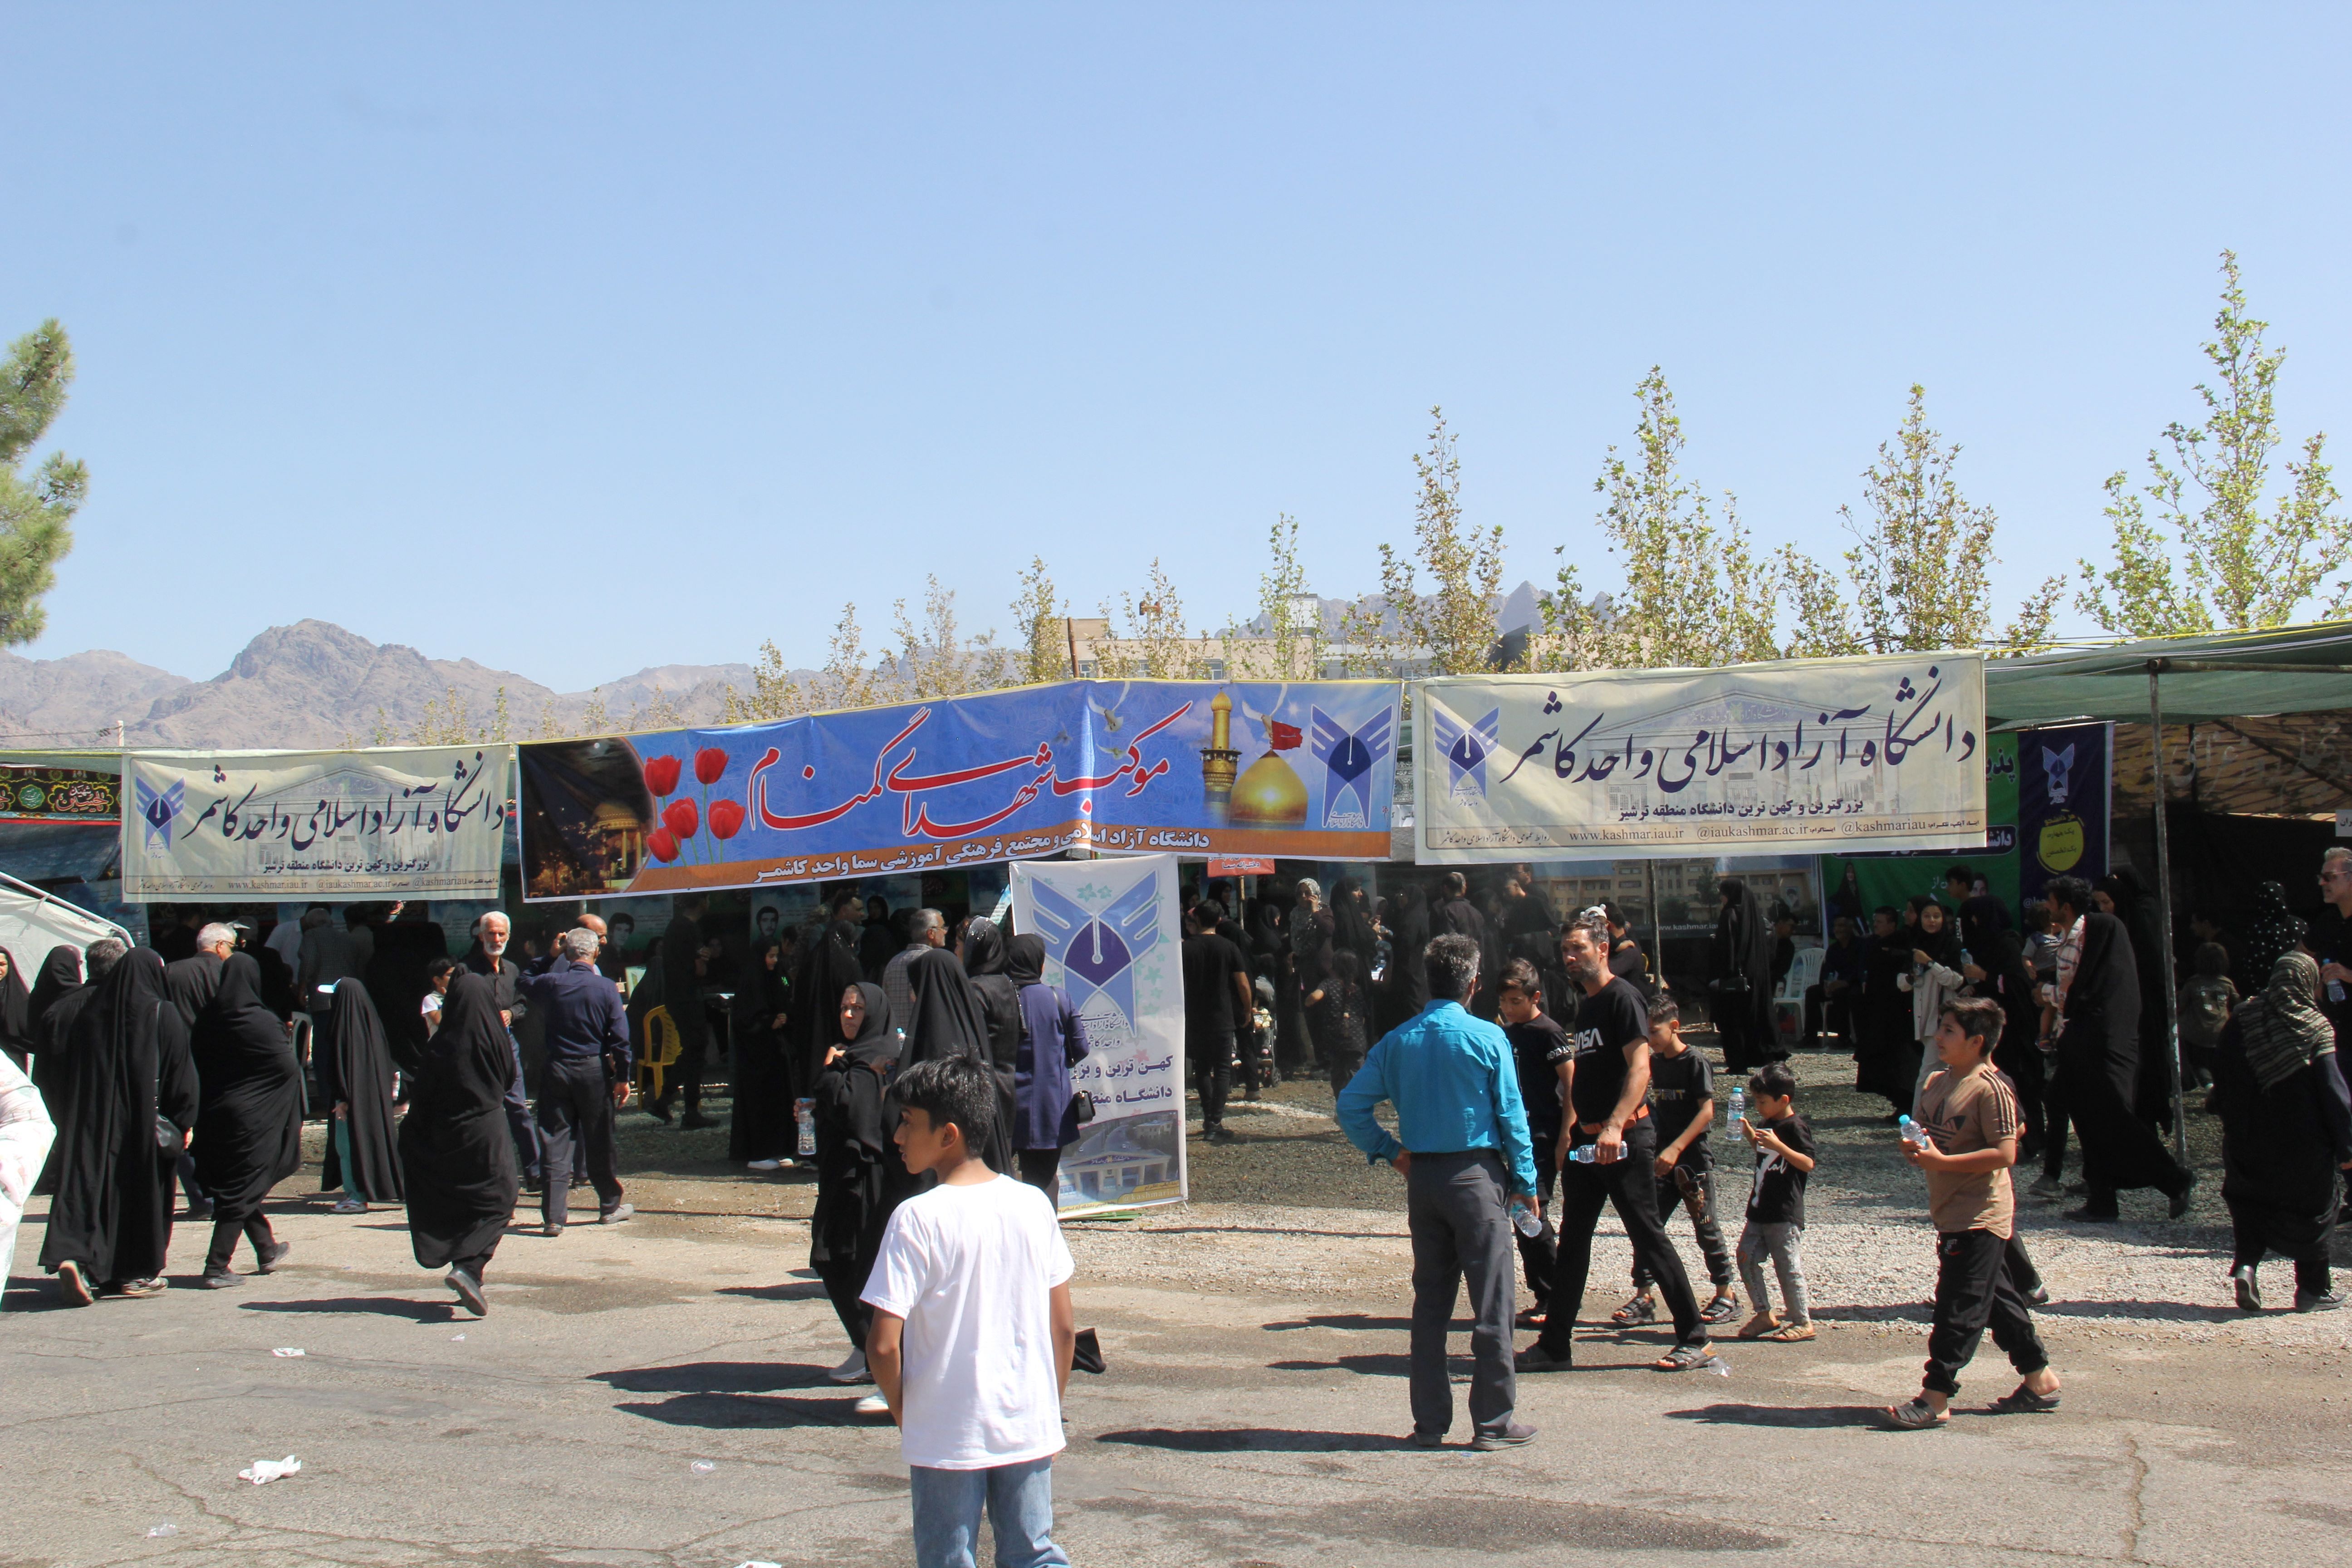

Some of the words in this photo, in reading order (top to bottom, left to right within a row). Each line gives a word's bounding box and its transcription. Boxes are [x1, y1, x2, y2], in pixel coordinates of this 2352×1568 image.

[1860, 665, 1976, 767] دانشگاه
[1499, 690, 1604, 784] کاشمر
[1771, 704, 1871, 772] آزاد
[1052, 700, 1193, 815] موکب
[1572, 733, 1653, 784] واحد
[1657, 727, 1767, 793] اسلامی
[748, 706, 931, 831] گمنام
[428, 750, 505, 833] دانشگاه
[887, 741, 1056, 839] شهدای
[181, 764, 258, 840] کاشمر
[368, 782, 438, 835] آزاد
[1652, 804, 1686, 816] منطقه
[1690, 802, 1735, 816] دانشگاه
[1738, 800, 1765, 817] ترین
[1769, 799, 1793, 816] کهن
[1798, 804, 1805, 816] و
[1808, 798, 1863, 814] بزرگترین
[234, 801, 291, 841] واحد
[1618, 805, 1649, 822] ترشیز
[292, 798, 367, 851] اسلامی
[1697, 823, 1808, 841] @iaukashmar.ac.ir
[1841, 818, 1925, 836] @kashmariau
[1052, 834, 1060, 850] و
[1060, 822, 1107, 846] اسلامی
[1108, 827, 1148, 851] آزاد
[1148, 829, 1210, 848] دانشگاه
[1440, 831, 1457, 846] کاشمر
[1455, 835, 1466, 843] واحد
[1498, 827, 1515, 842] دانشگاه
[1569, 828, 1684, 840] www.kashmar.iau.ir
[946, 837, 1003, 864] فرهنگی
[1004, 835, 1051, 857] مجتمع
[287, 860, 309, 870] منطقه
[312, 859, 342, 870] دانشگاه
[345, 859, 363, 872] ترین
[365, 859, 383, 872] کهن
[392, 859, 430, 872] بزرگترین
[811, 856, 849, 876] واحد
[851, 853, 878, 870] سما
[880, 844, 944, 871] آموزشی
[263, 861, 285, 874] ترشیز
[386, 863, 391, 872] و
[753, 858, 809, 884] کاشمر
[228, 878, 308, 889] www.kashmar.iau.ir
[317, 877, 391, 891] @iaukashmar.ac.ir
[413, 876, 467, 889] @kashmariau
[1102, 1038, 1120, 1048] واحد
[1094, 1066, 1102, 1078] و
[1105, 1058, 1134, 1077] ترین
[1138, 1054, 1174, 1075] کهن
[1089, 1090, 1112, 1104] منط
[1115, 1085, 1173, 1103] دانشگاه
[1654, 1089, 1685, 1100] PIRIT
